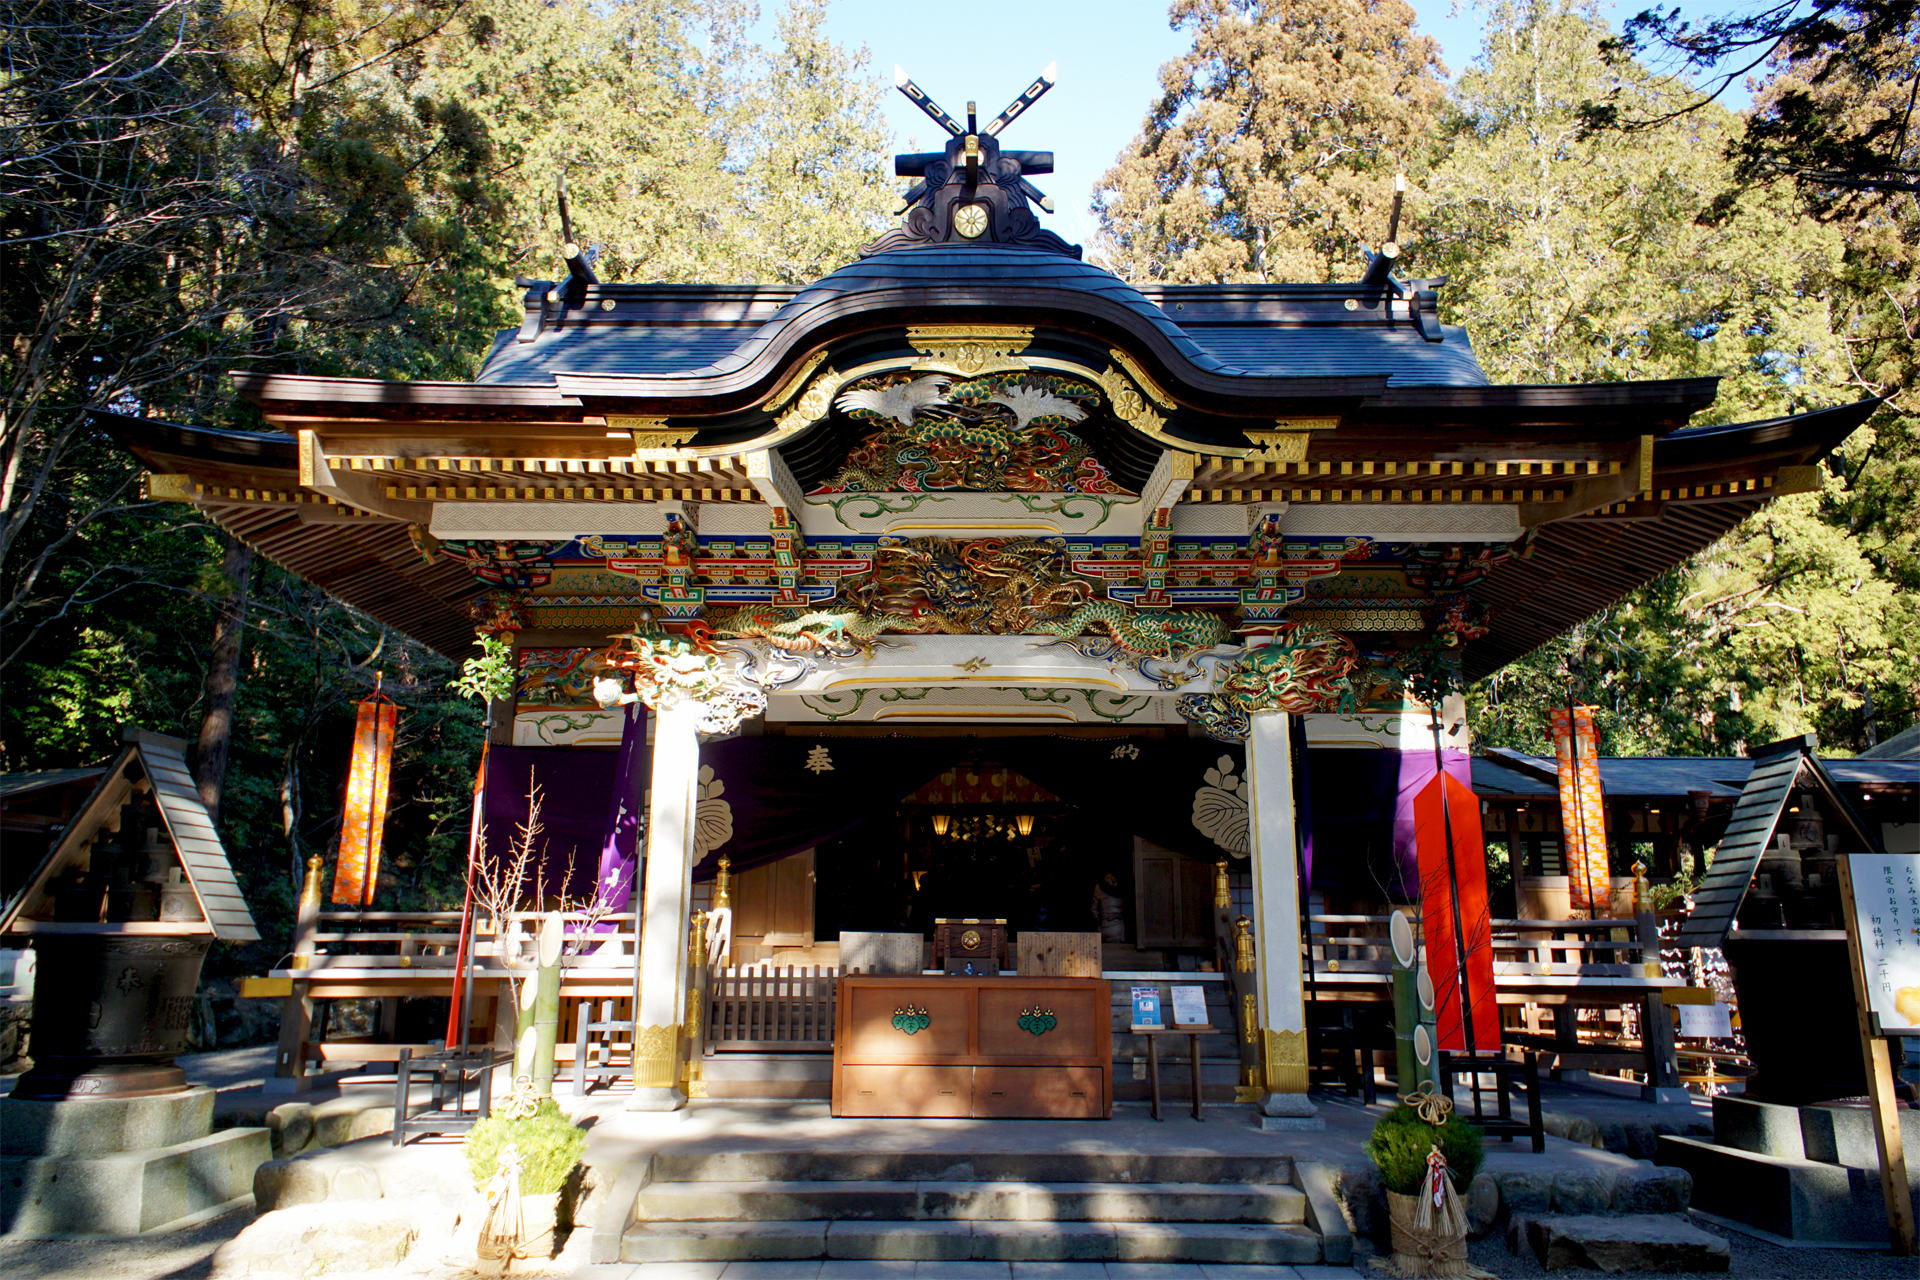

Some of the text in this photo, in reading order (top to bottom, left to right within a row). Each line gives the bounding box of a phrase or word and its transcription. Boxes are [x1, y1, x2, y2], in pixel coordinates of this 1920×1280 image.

[804, 744, 835, 775] 奉
[1871, 914, 1892, 993] 初穂料 二千円
